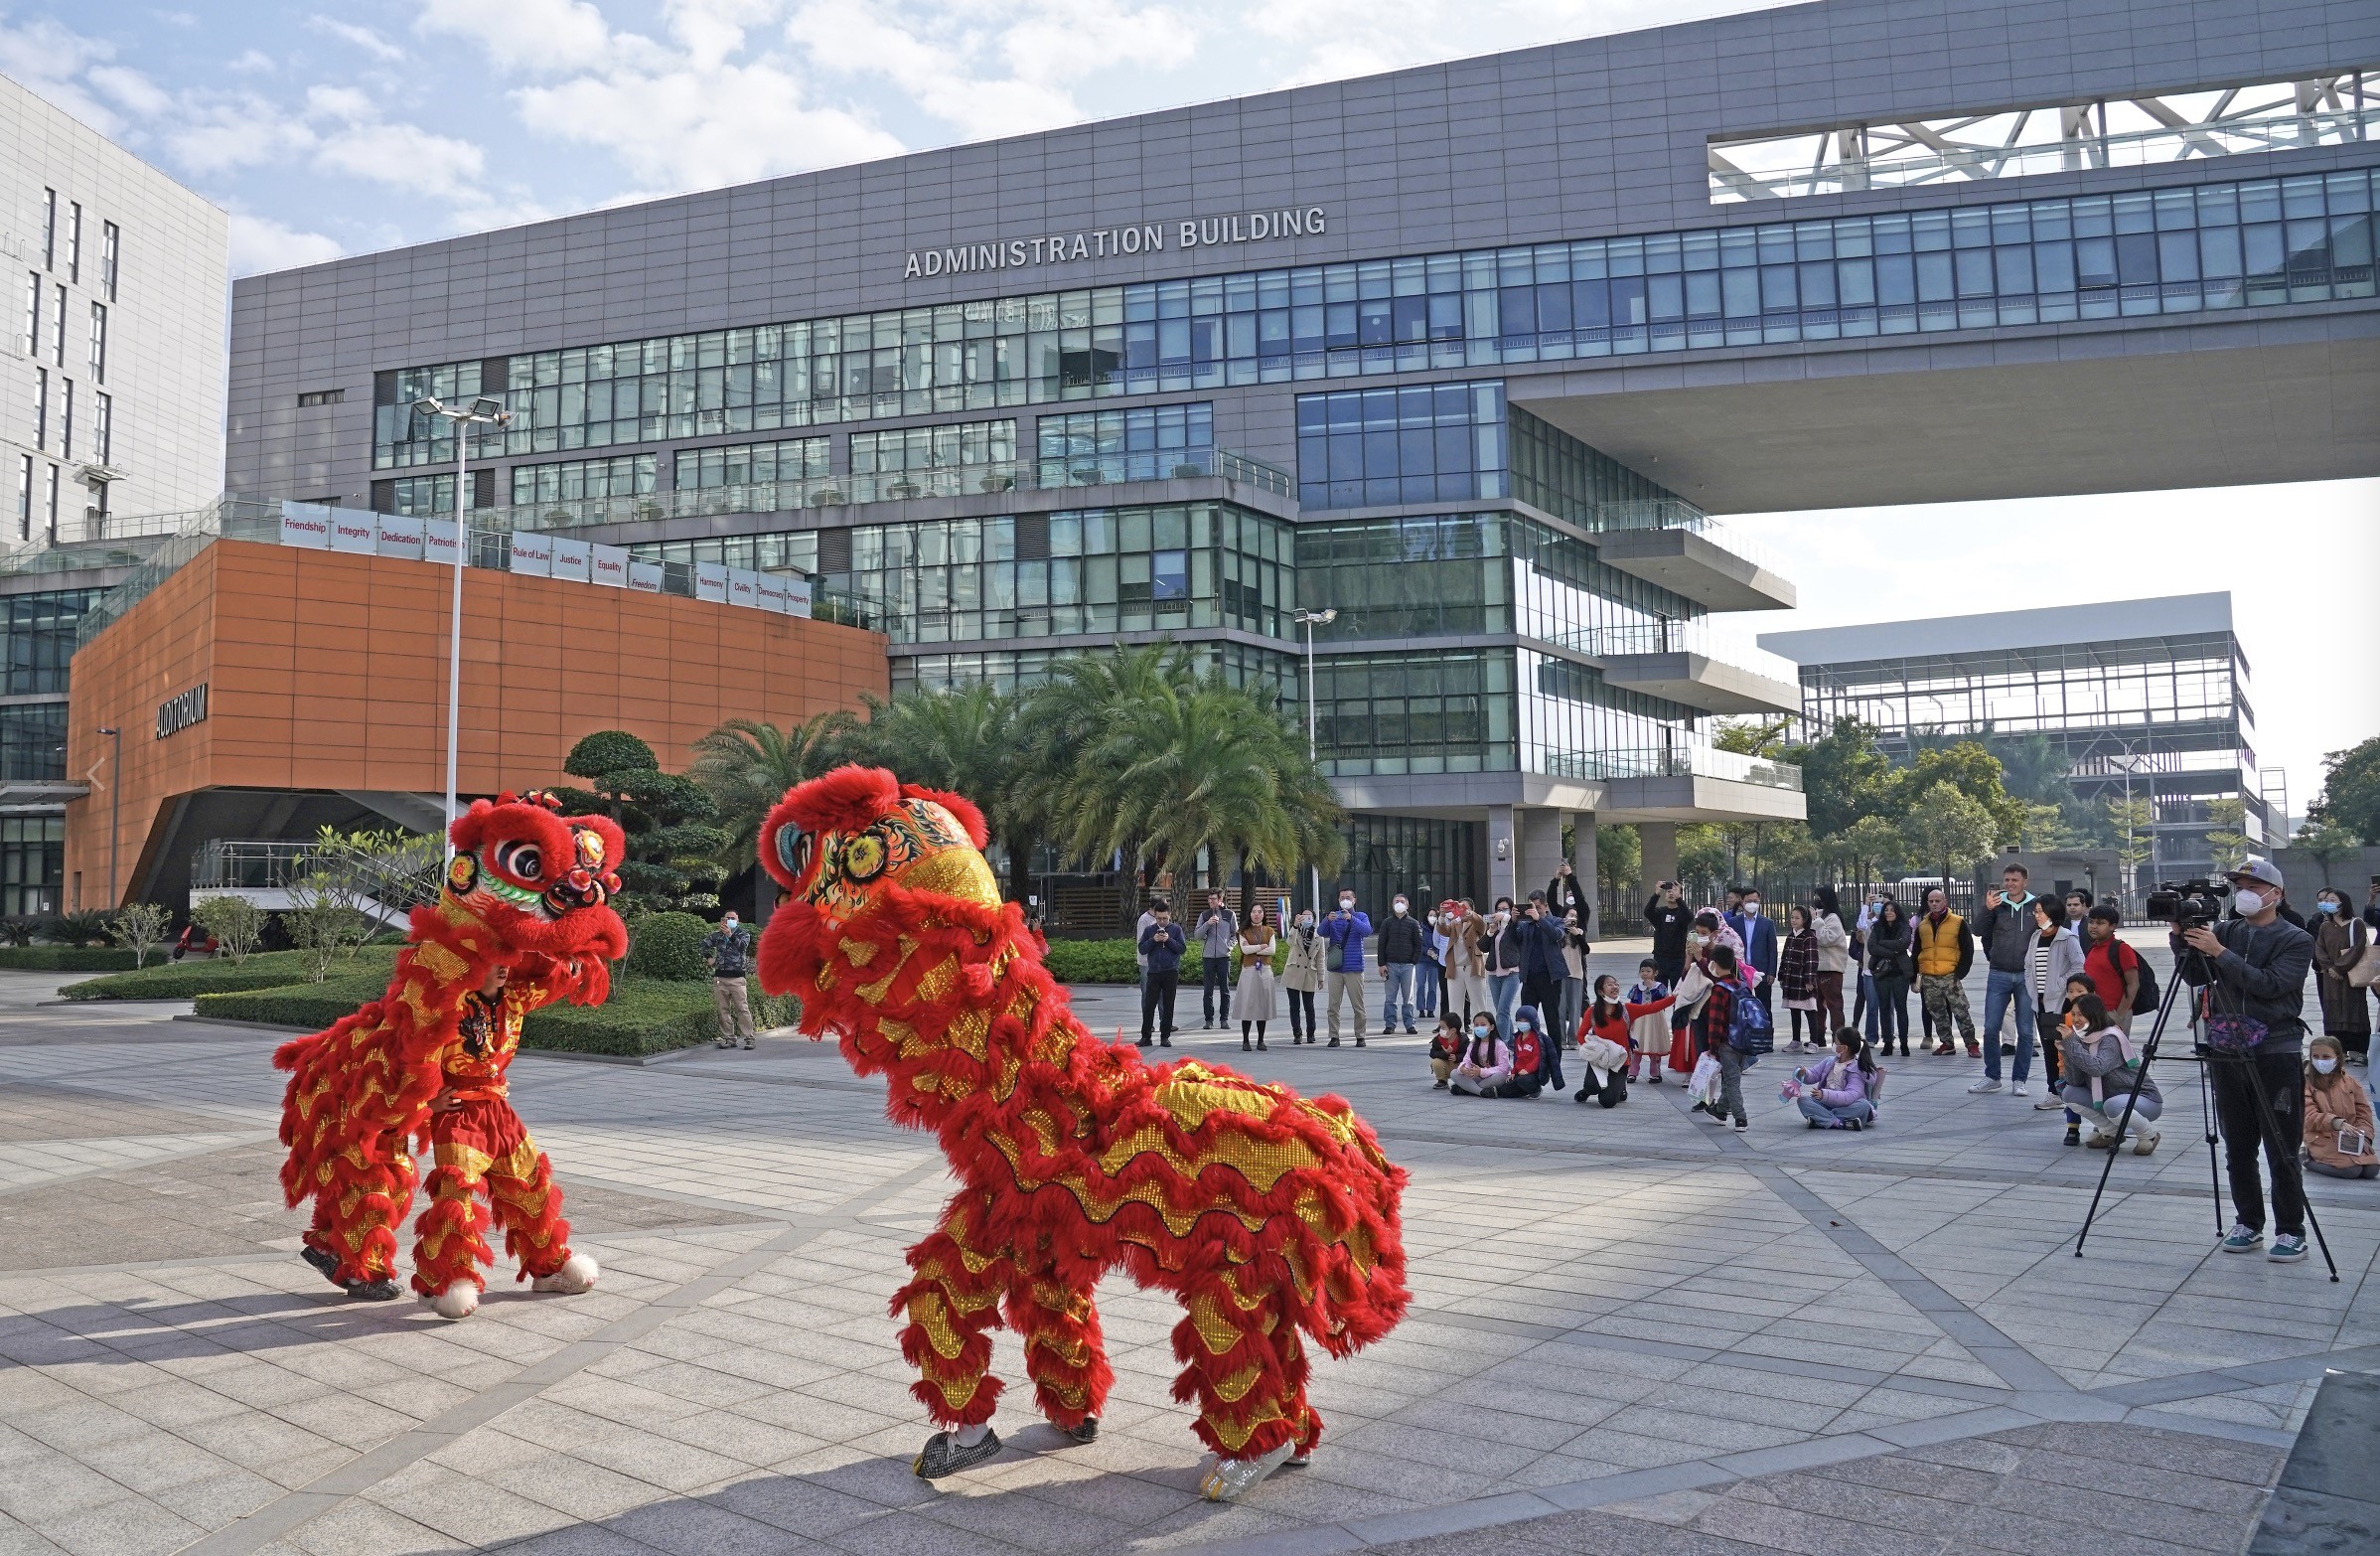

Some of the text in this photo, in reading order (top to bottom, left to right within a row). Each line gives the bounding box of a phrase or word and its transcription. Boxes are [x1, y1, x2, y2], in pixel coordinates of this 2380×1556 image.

[904, 207, 1326, 279] ADMINISTRATION BUILDING
[285, 519, 326, 534] Friendship
[338, 526, 370, 539] Integrity
[381, 532, 420, 545] Dedication
[513, 547, 549, 560] Rule of Law
[560, 554, 581, 564] Justice
[598, 560, 621, 572] Equality
[632, 578, 657, 590] Freedom
[699, 576, 723, 589] Harmony
[734, 582, 751, 594] Civility
[758, 587, 784, 599] Democracy
[788, 592, 809, 605] Prosperity
[156, 683, 207, 739] AUDITORIUM
